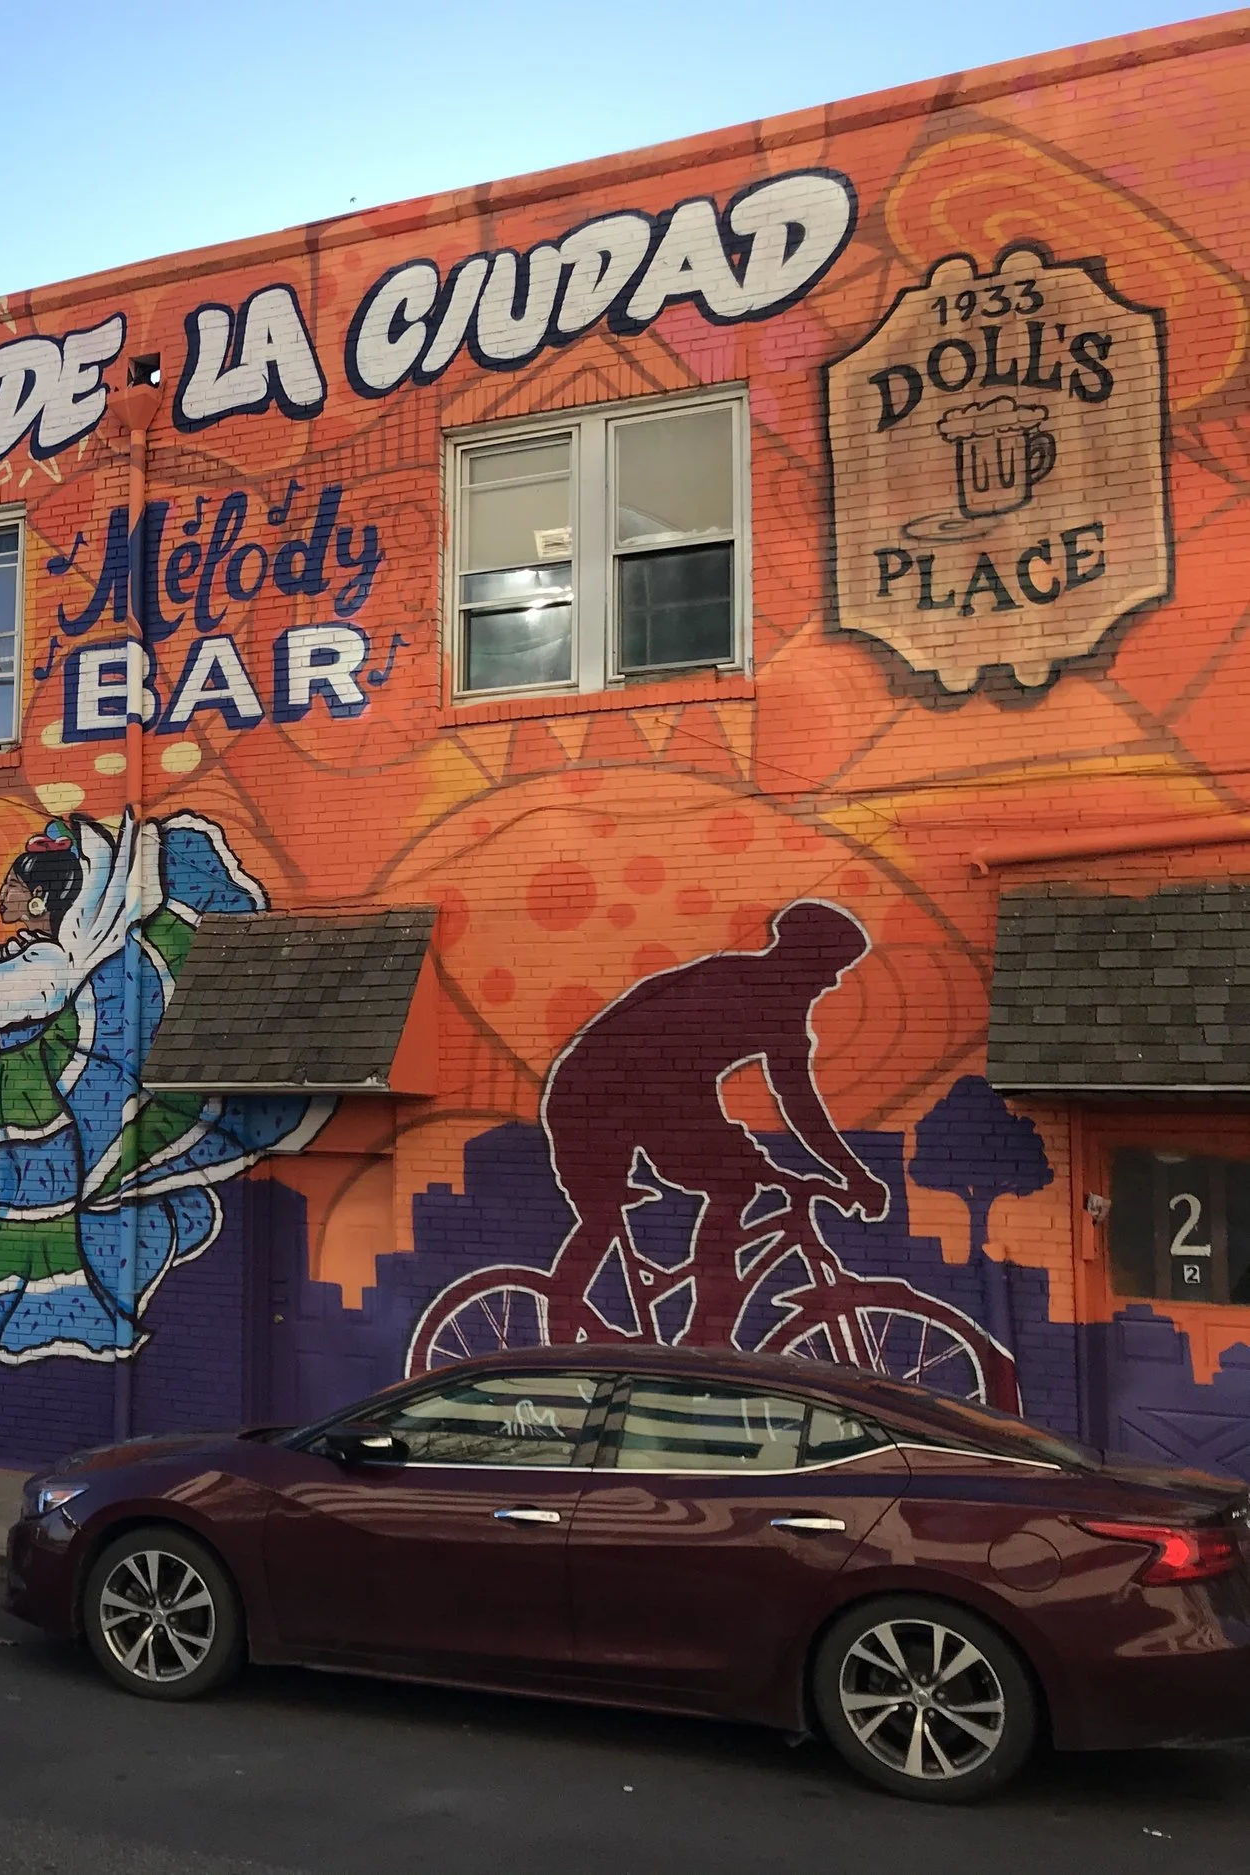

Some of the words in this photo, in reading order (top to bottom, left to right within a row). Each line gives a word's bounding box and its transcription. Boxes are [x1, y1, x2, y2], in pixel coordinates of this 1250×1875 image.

[172, 282, 328, 433] LA
[344, 167, 859, 400] CIUDAD
[930, 279, 1045, 326] 1933
[868, 319, 1115, 434] DOLL'S
[57, 483, 386, 643] Melody
[873, 521, 1107, 617] PLACE
[61, 621, 371, 743] BAR
[1169, 1193, 1211, 1257] 2
[1186, 1266, 1198, 1283] 2
